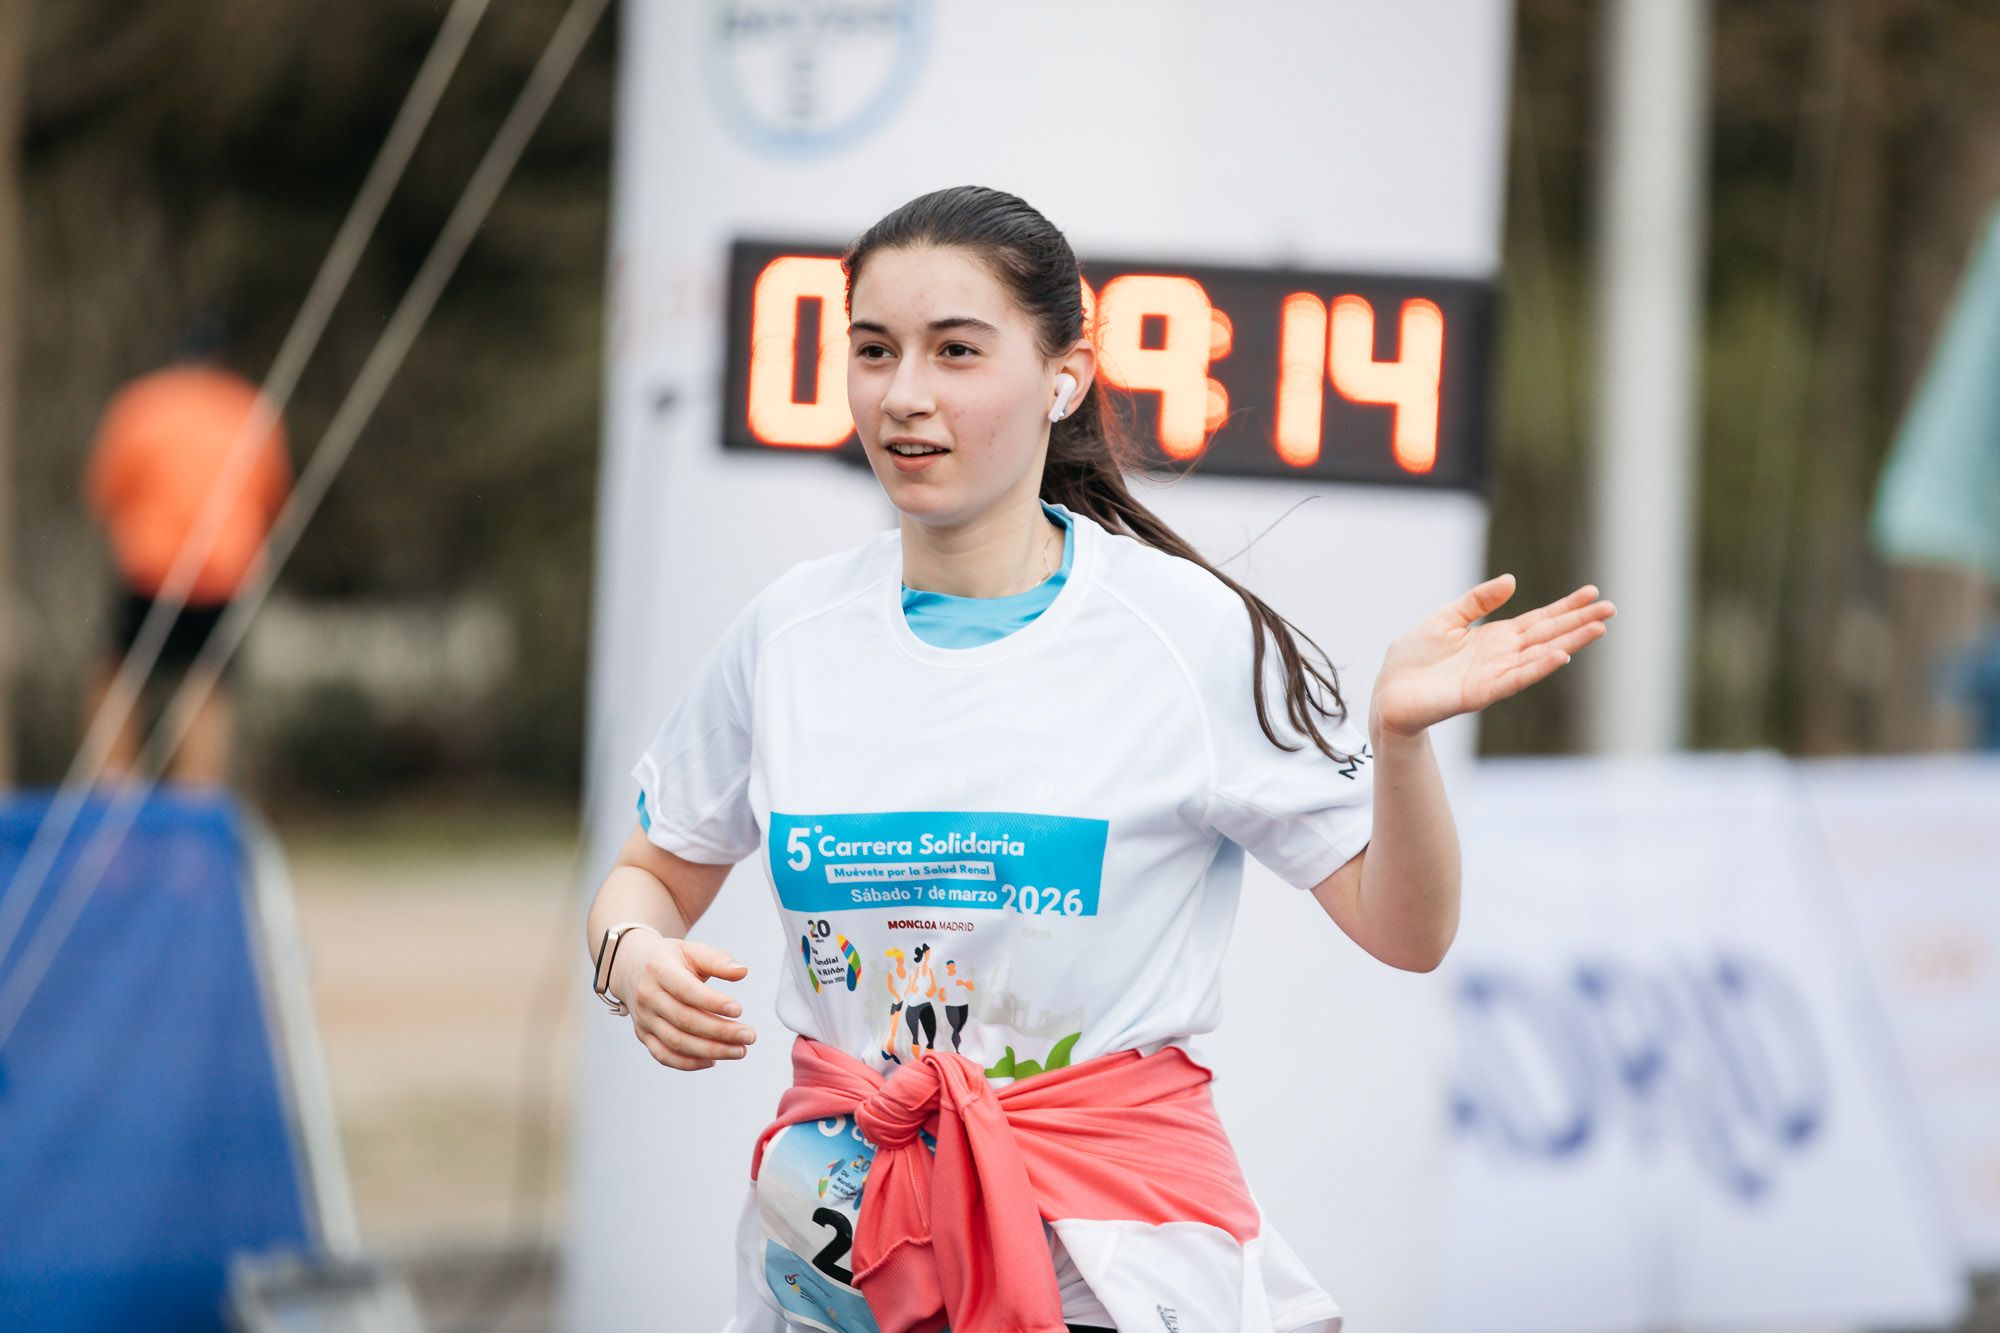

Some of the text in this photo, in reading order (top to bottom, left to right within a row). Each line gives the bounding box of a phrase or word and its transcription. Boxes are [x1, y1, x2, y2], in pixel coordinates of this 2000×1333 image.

[818, 835, 912, 857] Carrera
[920, 832, 1025, 857] Solidaria
[834, 864, 990, 879] Muévete por la Salud Renal
[850, 885, 998, 903] Sábado 7 de marzo
[1001, 883, 1084, 917] 2026
[888, 920, 974, 932] MONCLOA MADRID
